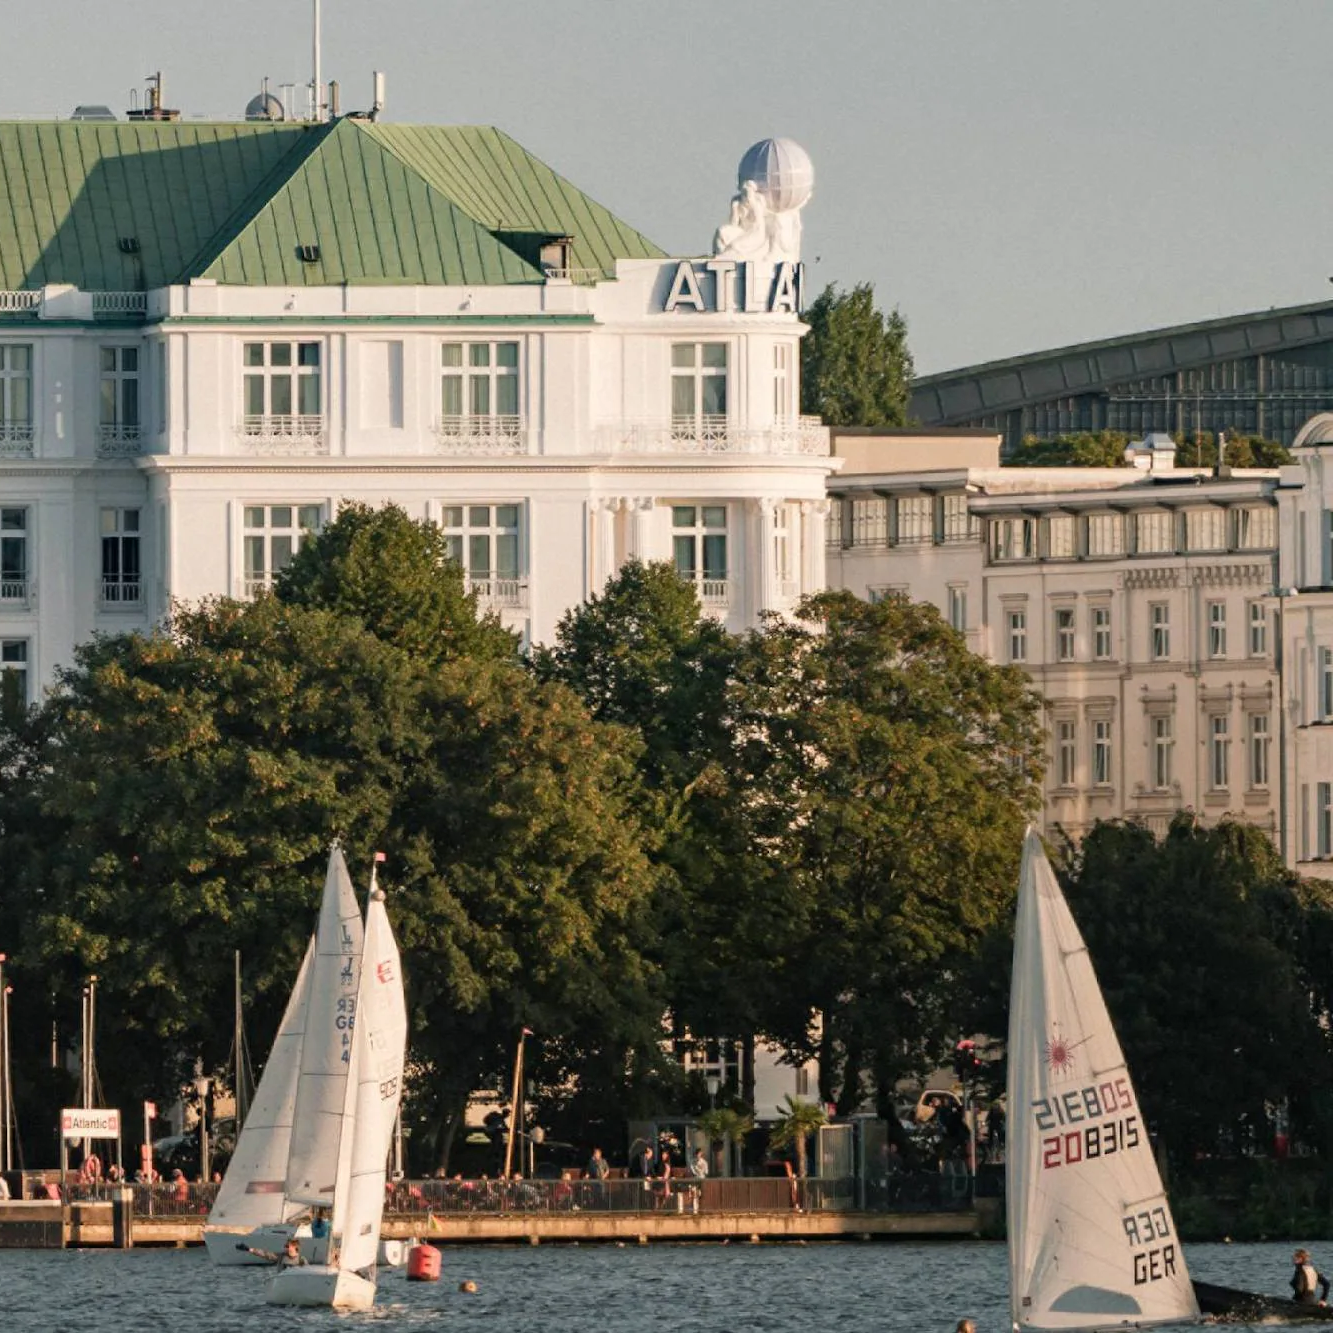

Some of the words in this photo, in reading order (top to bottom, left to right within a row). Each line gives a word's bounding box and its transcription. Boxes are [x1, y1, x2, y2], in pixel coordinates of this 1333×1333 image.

[73, 1117, 107, 1129] Atlantic
[1043, 1115, 1139, 1170] 208315
[1134, 1244, 1176, 1286] GER
